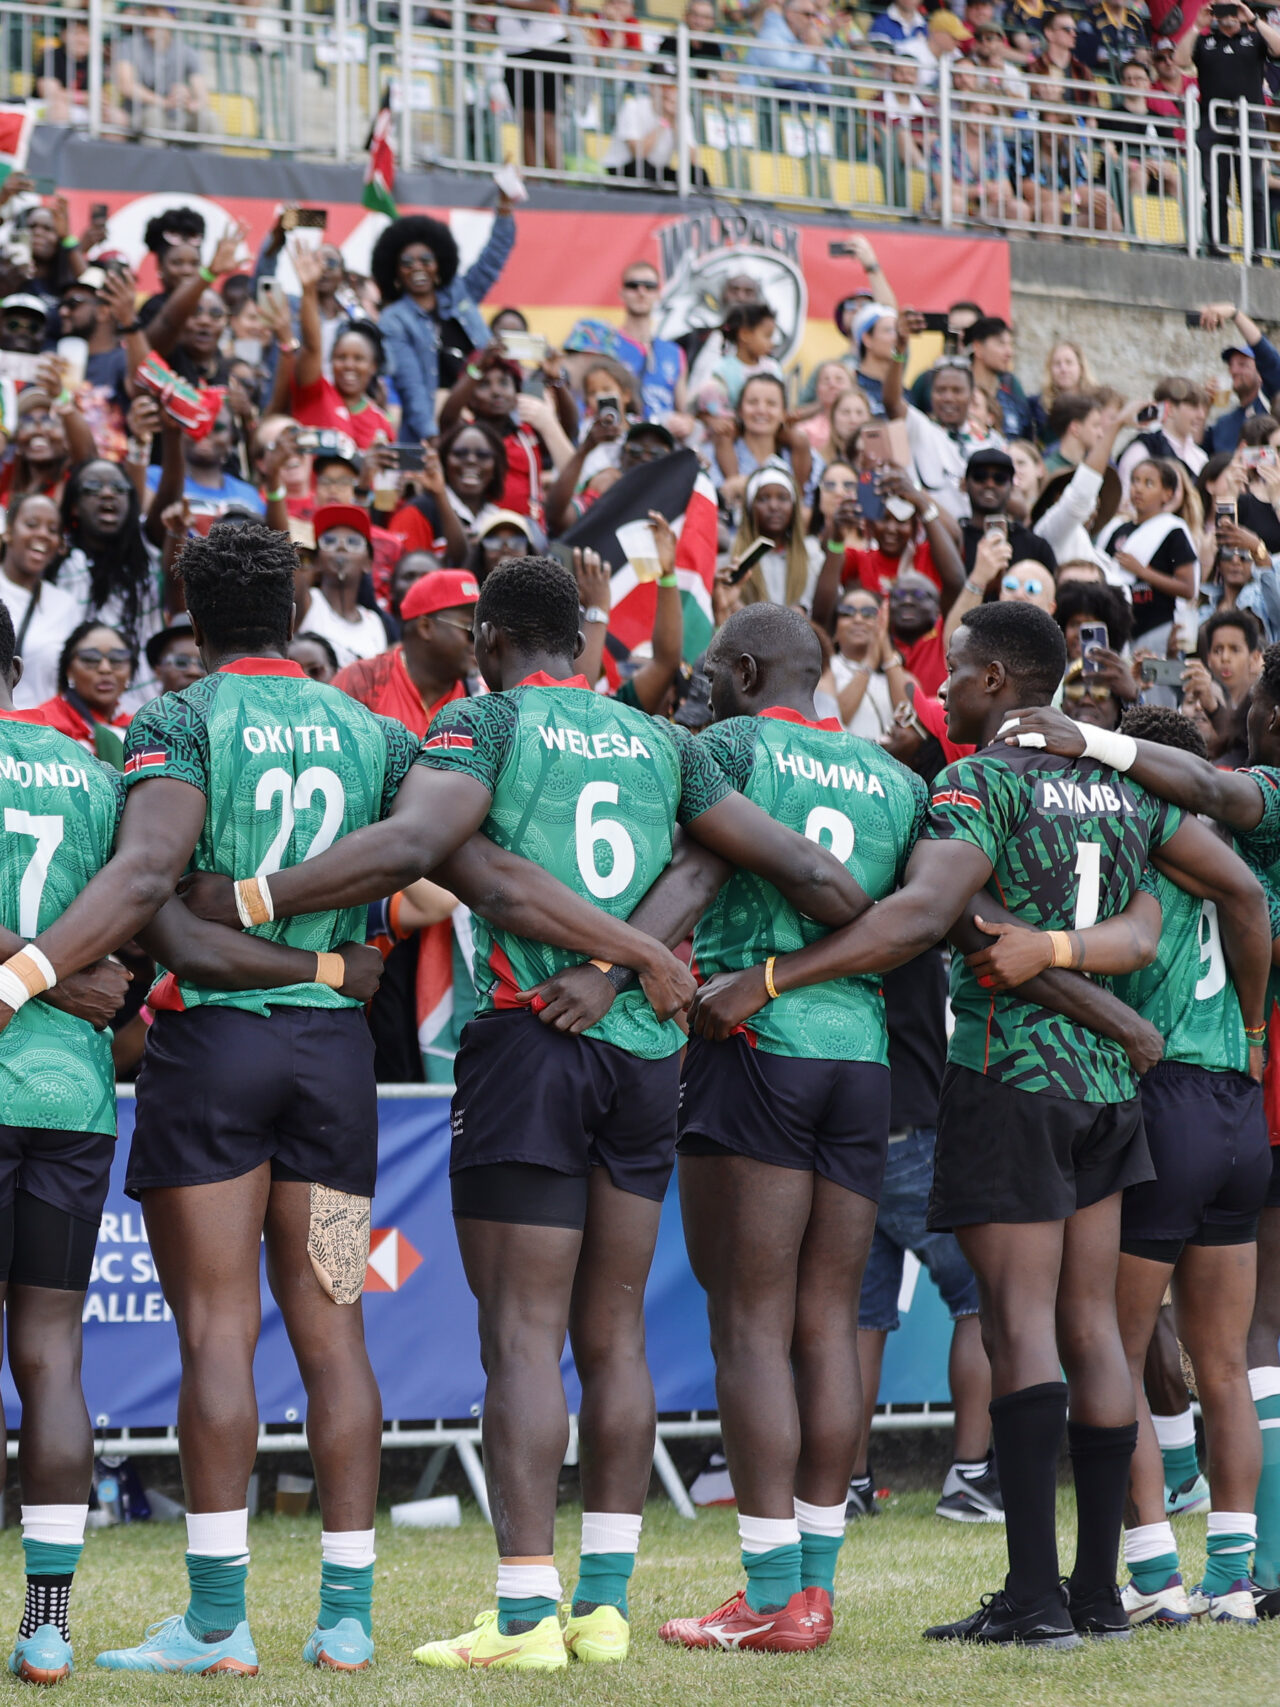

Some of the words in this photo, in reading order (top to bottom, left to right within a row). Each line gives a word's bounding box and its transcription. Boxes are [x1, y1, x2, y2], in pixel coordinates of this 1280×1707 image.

[538, 725, 651, 760] WEKESA
[775, 752, 885, 798] HUMWA
[4, 807, 64, 939] 7
[254, 766, 345, 877] 22
[575, 780, 636, 899] 6
